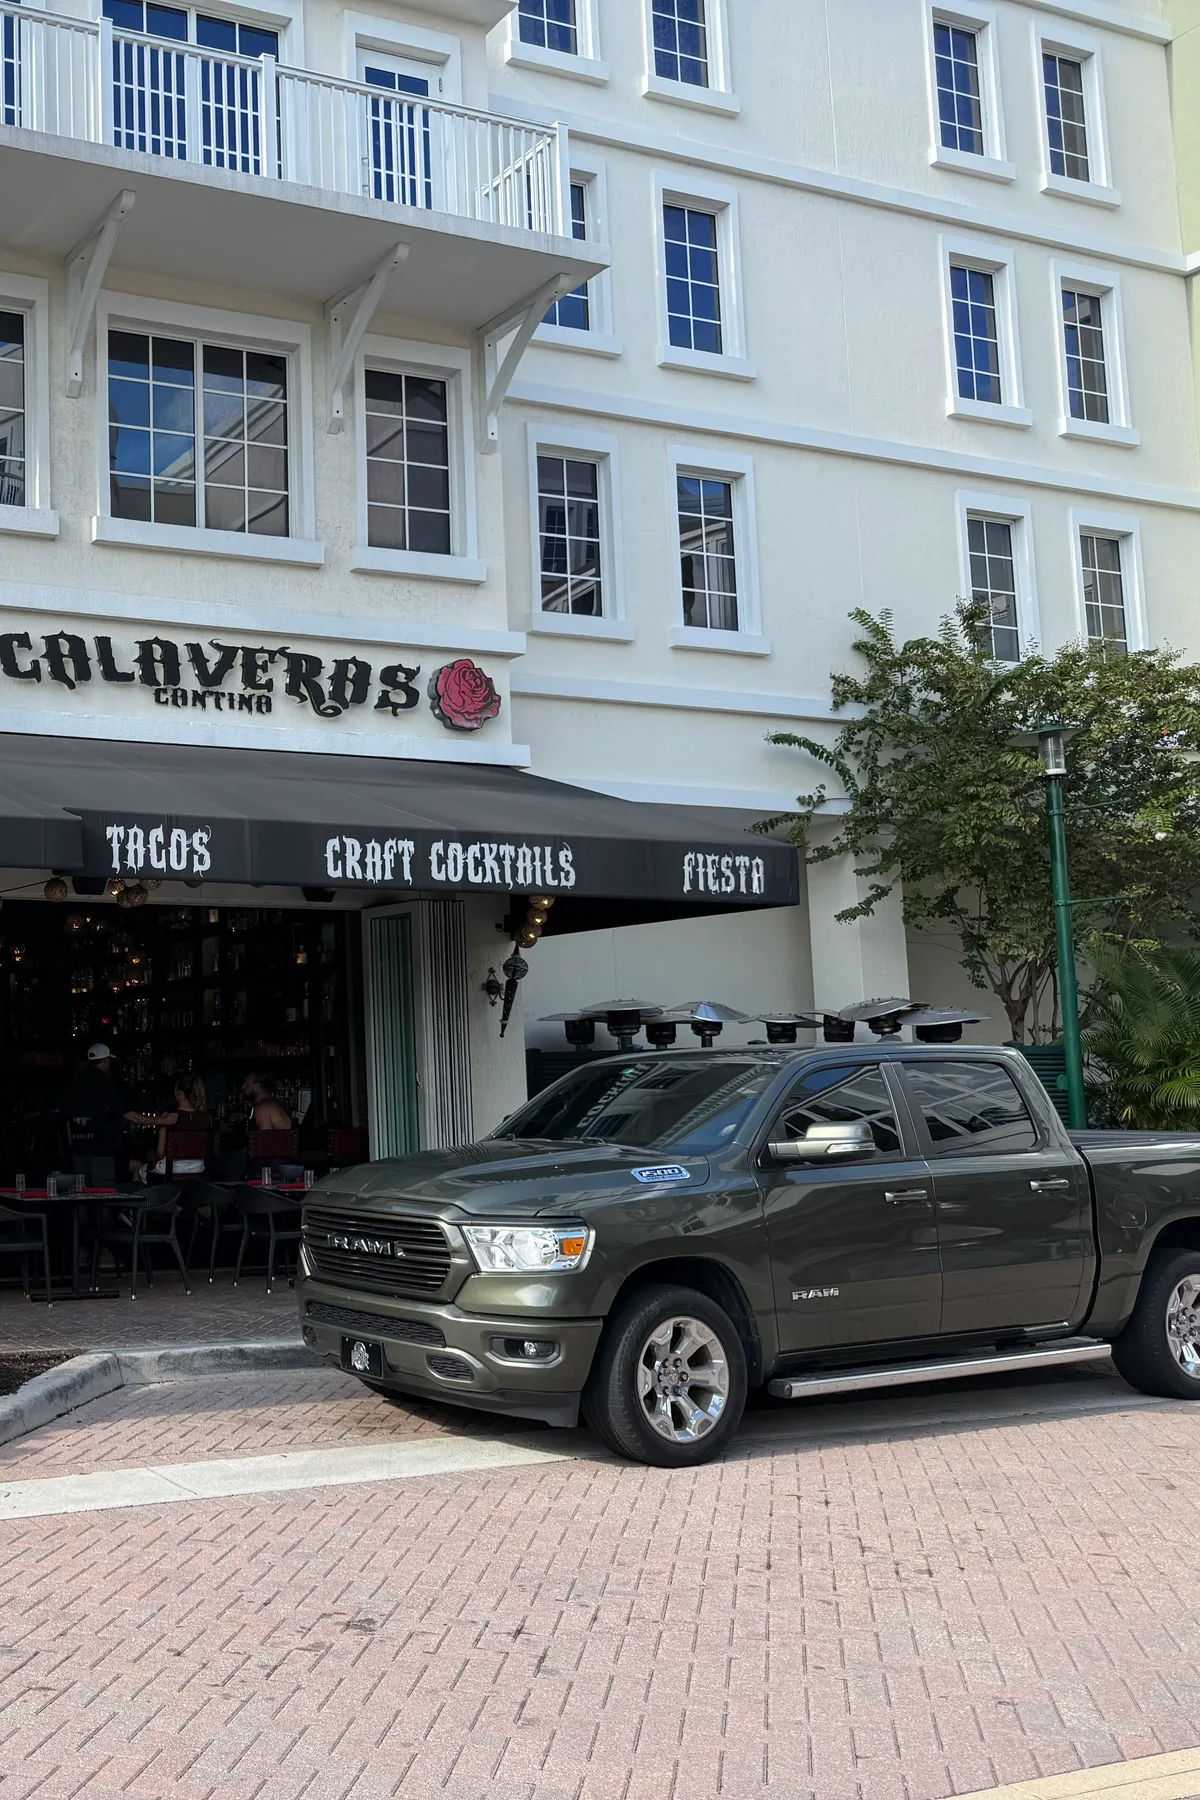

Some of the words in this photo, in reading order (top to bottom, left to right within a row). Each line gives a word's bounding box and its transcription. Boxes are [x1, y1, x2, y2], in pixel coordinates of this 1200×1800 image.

[153, 687, 272, 715] CANTINA
[106, 824, 211, 877] TACOS
[324, 835, 414, 885] CRAFT
[428, 839, 576, 890] COCKTAILS
[682, 851, 764, 895] FIESTA
[333, 1237, 392, 1256] RAM
[792, 1287, 839, 1300] RAM
